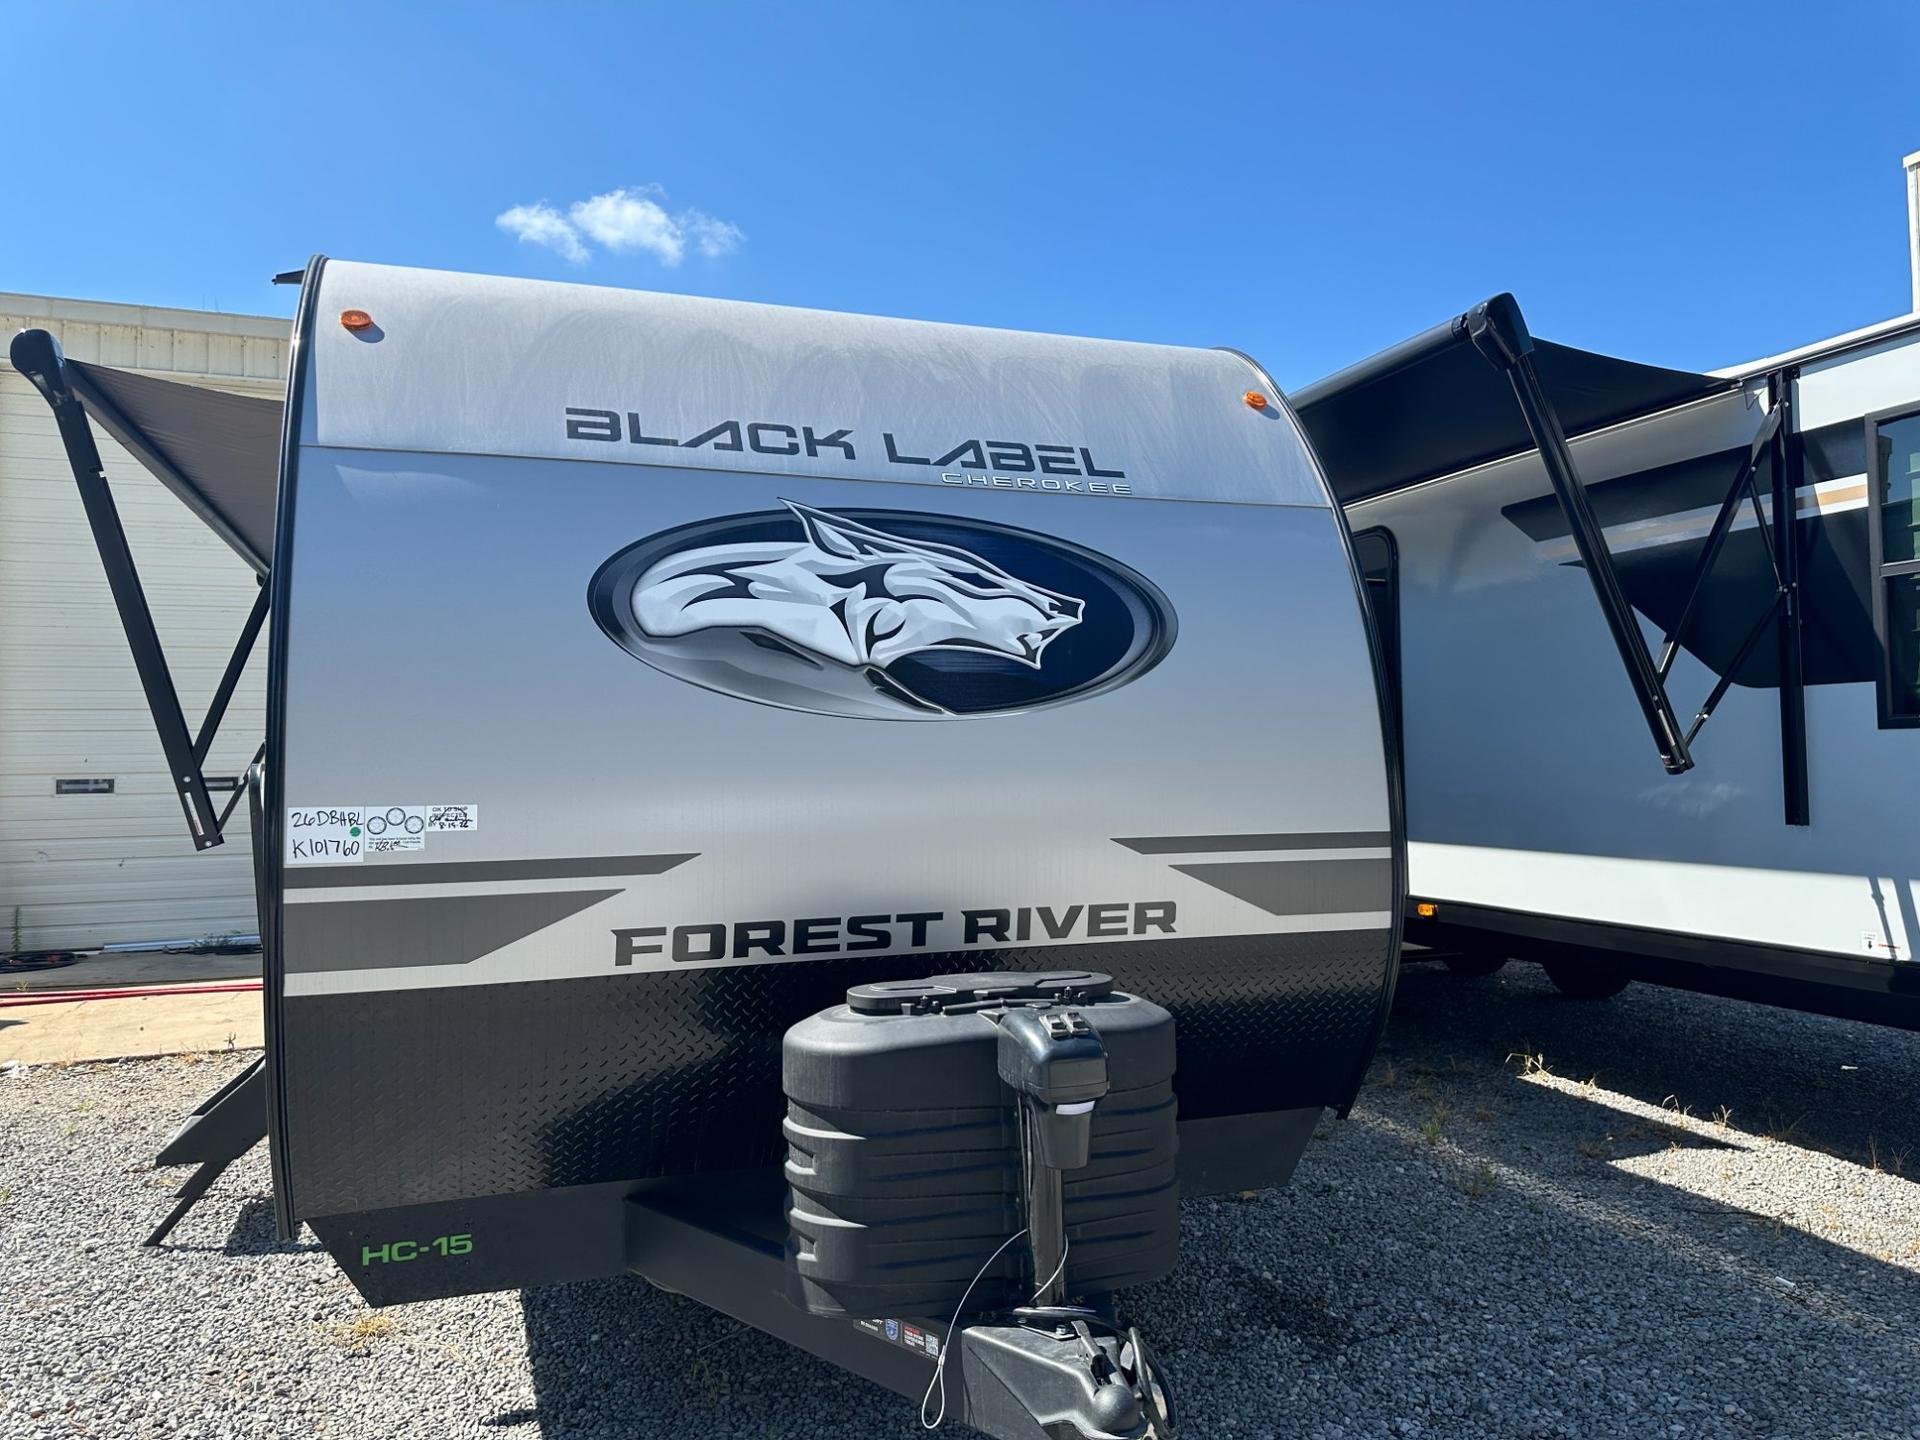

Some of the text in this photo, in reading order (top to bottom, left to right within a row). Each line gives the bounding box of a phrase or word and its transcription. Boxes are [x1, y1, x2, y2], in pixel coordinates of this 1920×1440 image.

[564, 406, 1126, 479] BLACK LABEL
[940, 472, 1133, 495] CHEROKEE
[609, 899, 1178, 968] FOREST RIVER
[361, 1233, 474, 1267] HC-15
